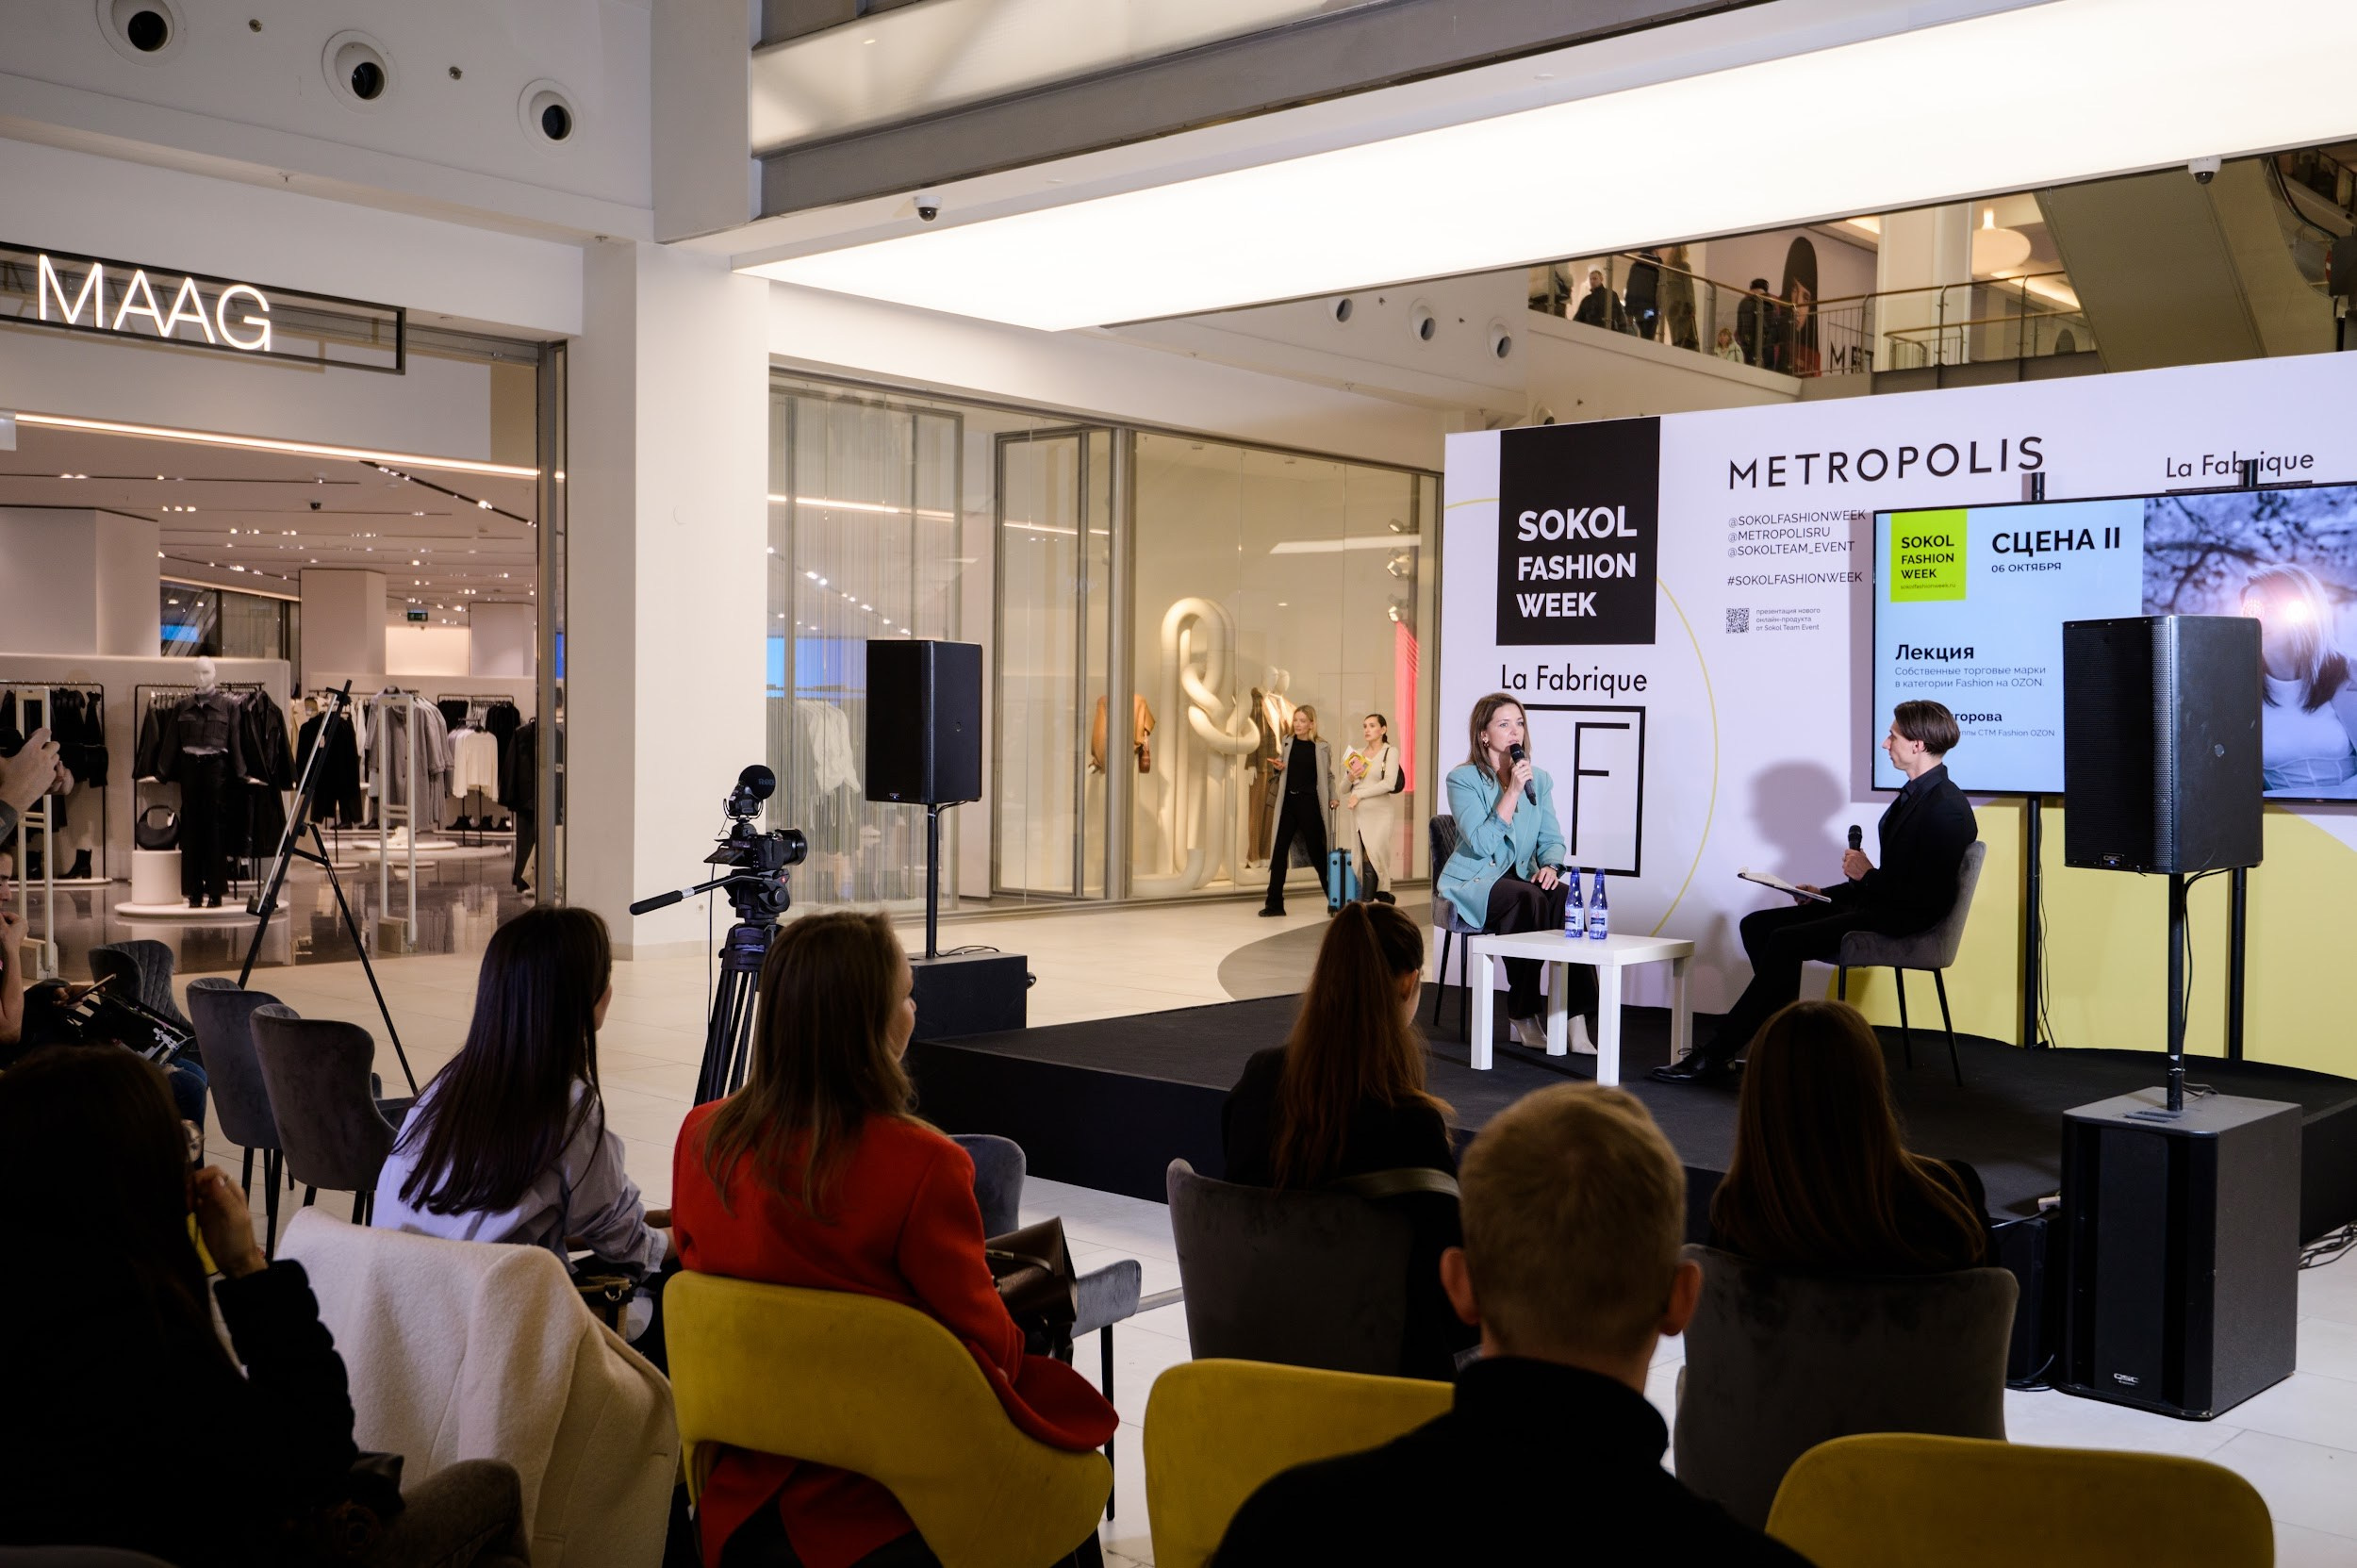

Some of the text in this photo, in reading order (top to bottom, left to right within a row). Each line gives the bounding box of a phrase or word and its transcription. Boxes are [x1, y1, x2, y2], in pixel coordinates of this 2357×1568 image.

[38, 254, 271, 352] MAAG
[1729, 436, 2043, 490] METROPOLIS
[2167, 451, 2314, 478] La Fabique
[1517, 505, 1638, 542] SOKOL
[1728, 509, 1867, 528] @SOKOLFASHIONWEEK
[1728, 527, 1831, 543] @METROPOLISRU
[1901, 535, 1955, 549] SOKOL
[1991, 527, 2120, 557] СЦЕНА II
[1727, 541, 1855, 558] @SOKOLTEAM_EVENT
[1518, 553, 1637, 581] FASHION
[1901, 553, 1955, 565] FASHION
[1991, 562, 2062, 573] 06 ОКТЯБРЯ
[1727, 571, 1863, 586] #SOKOLFASHIONWEEK
[1901, 568, 1937, 579] WEEK
[1516, 592, 1597, 618] WEEK
[1895, 644, 1974, 662] Лекция
[1895, 667, 2046, 677] Собственные торговые марки
[1502, 663, 1647, 699] La Fabrique
[1903, 680, 1953, 689] категории
[1955, 678, 1993, 687] Fashion
[2011, 678, 2044, 687] OZON.
[1952, 713, 2003, 724] горова
[2113, 1373, 2139, 1383] QSC
